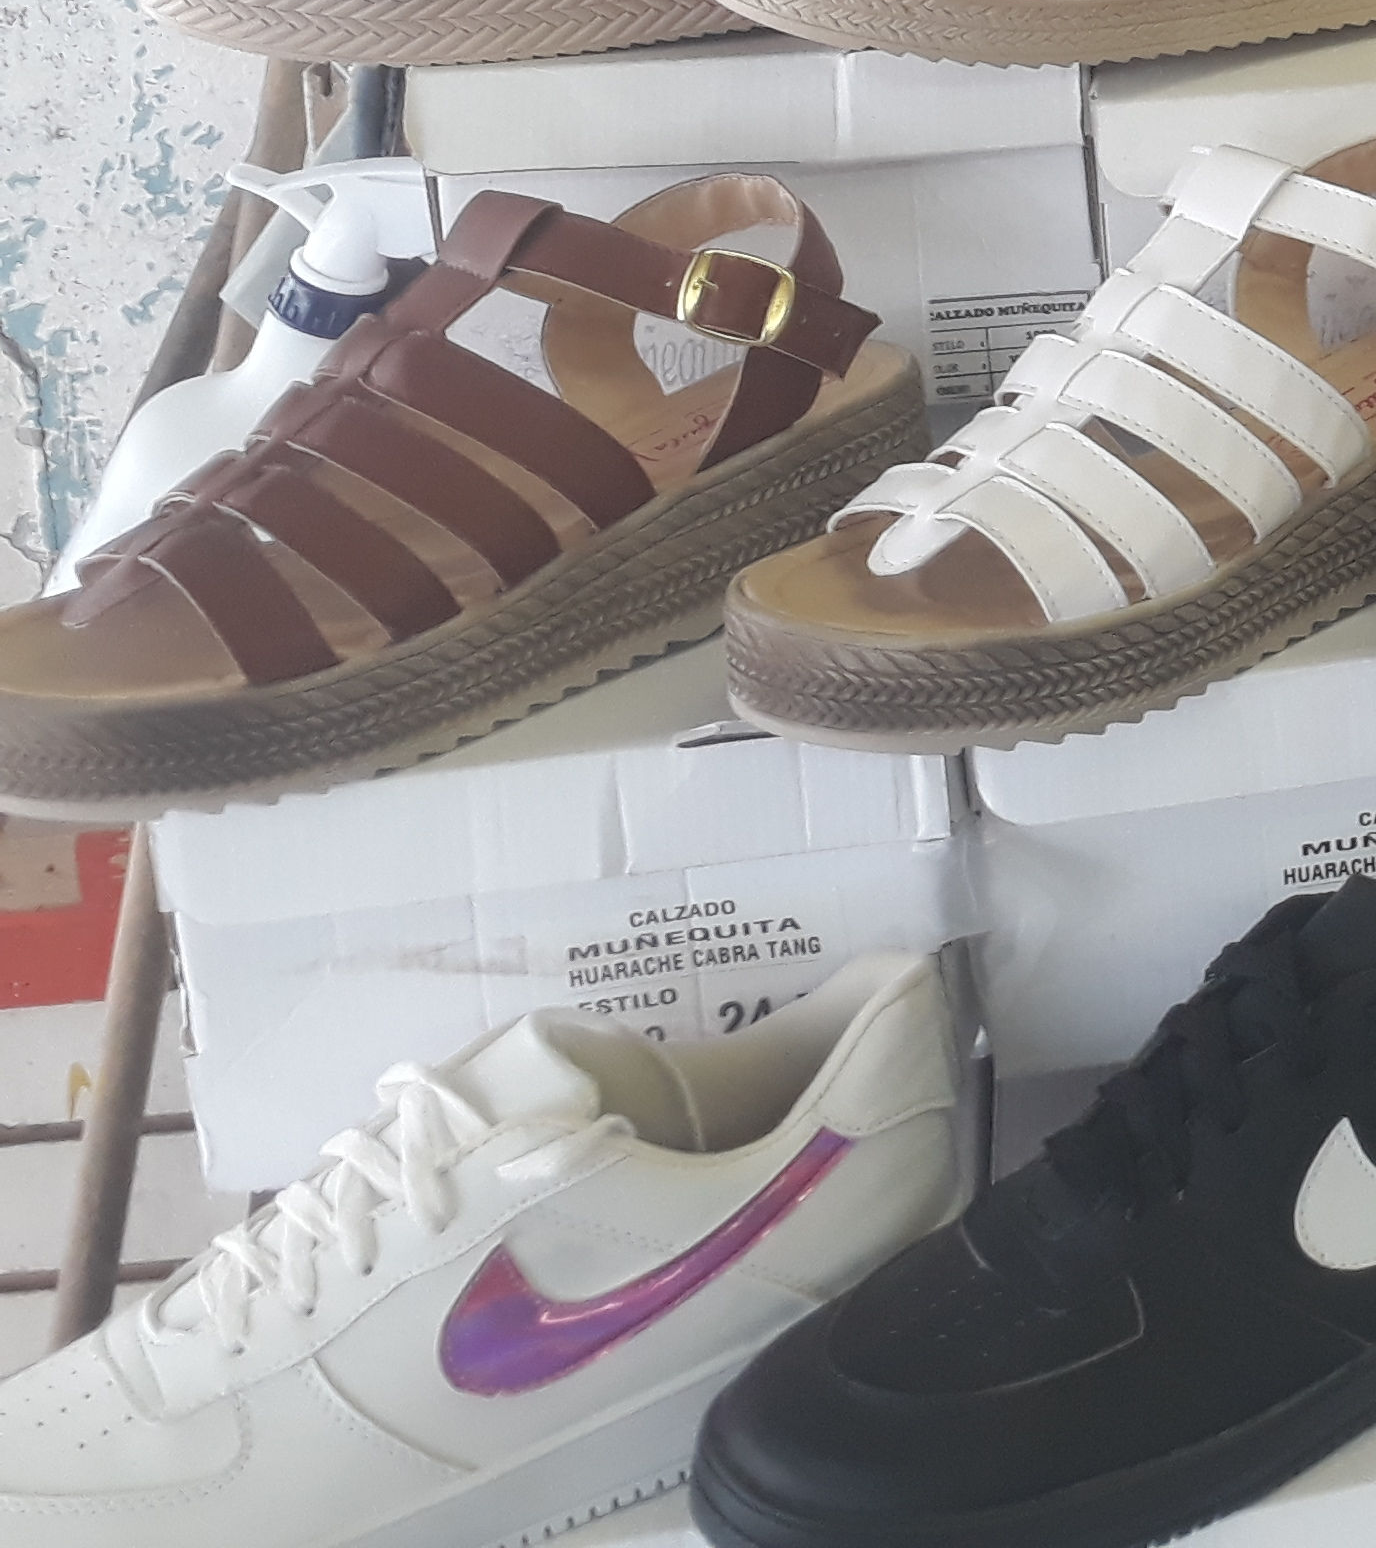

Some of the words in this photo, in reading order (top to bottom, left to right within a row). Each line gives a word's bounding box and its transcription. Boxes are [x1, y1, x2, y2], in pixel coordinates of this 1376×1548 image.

[629, 899, 737, 928] CALZADO
[567, 917, 802, 962] MUÑEQUITA
[568, 953, 685, 988] HUARACHE
[692, 943, 760, 968] CABRA
[767, 936, 822, 959] TANG
